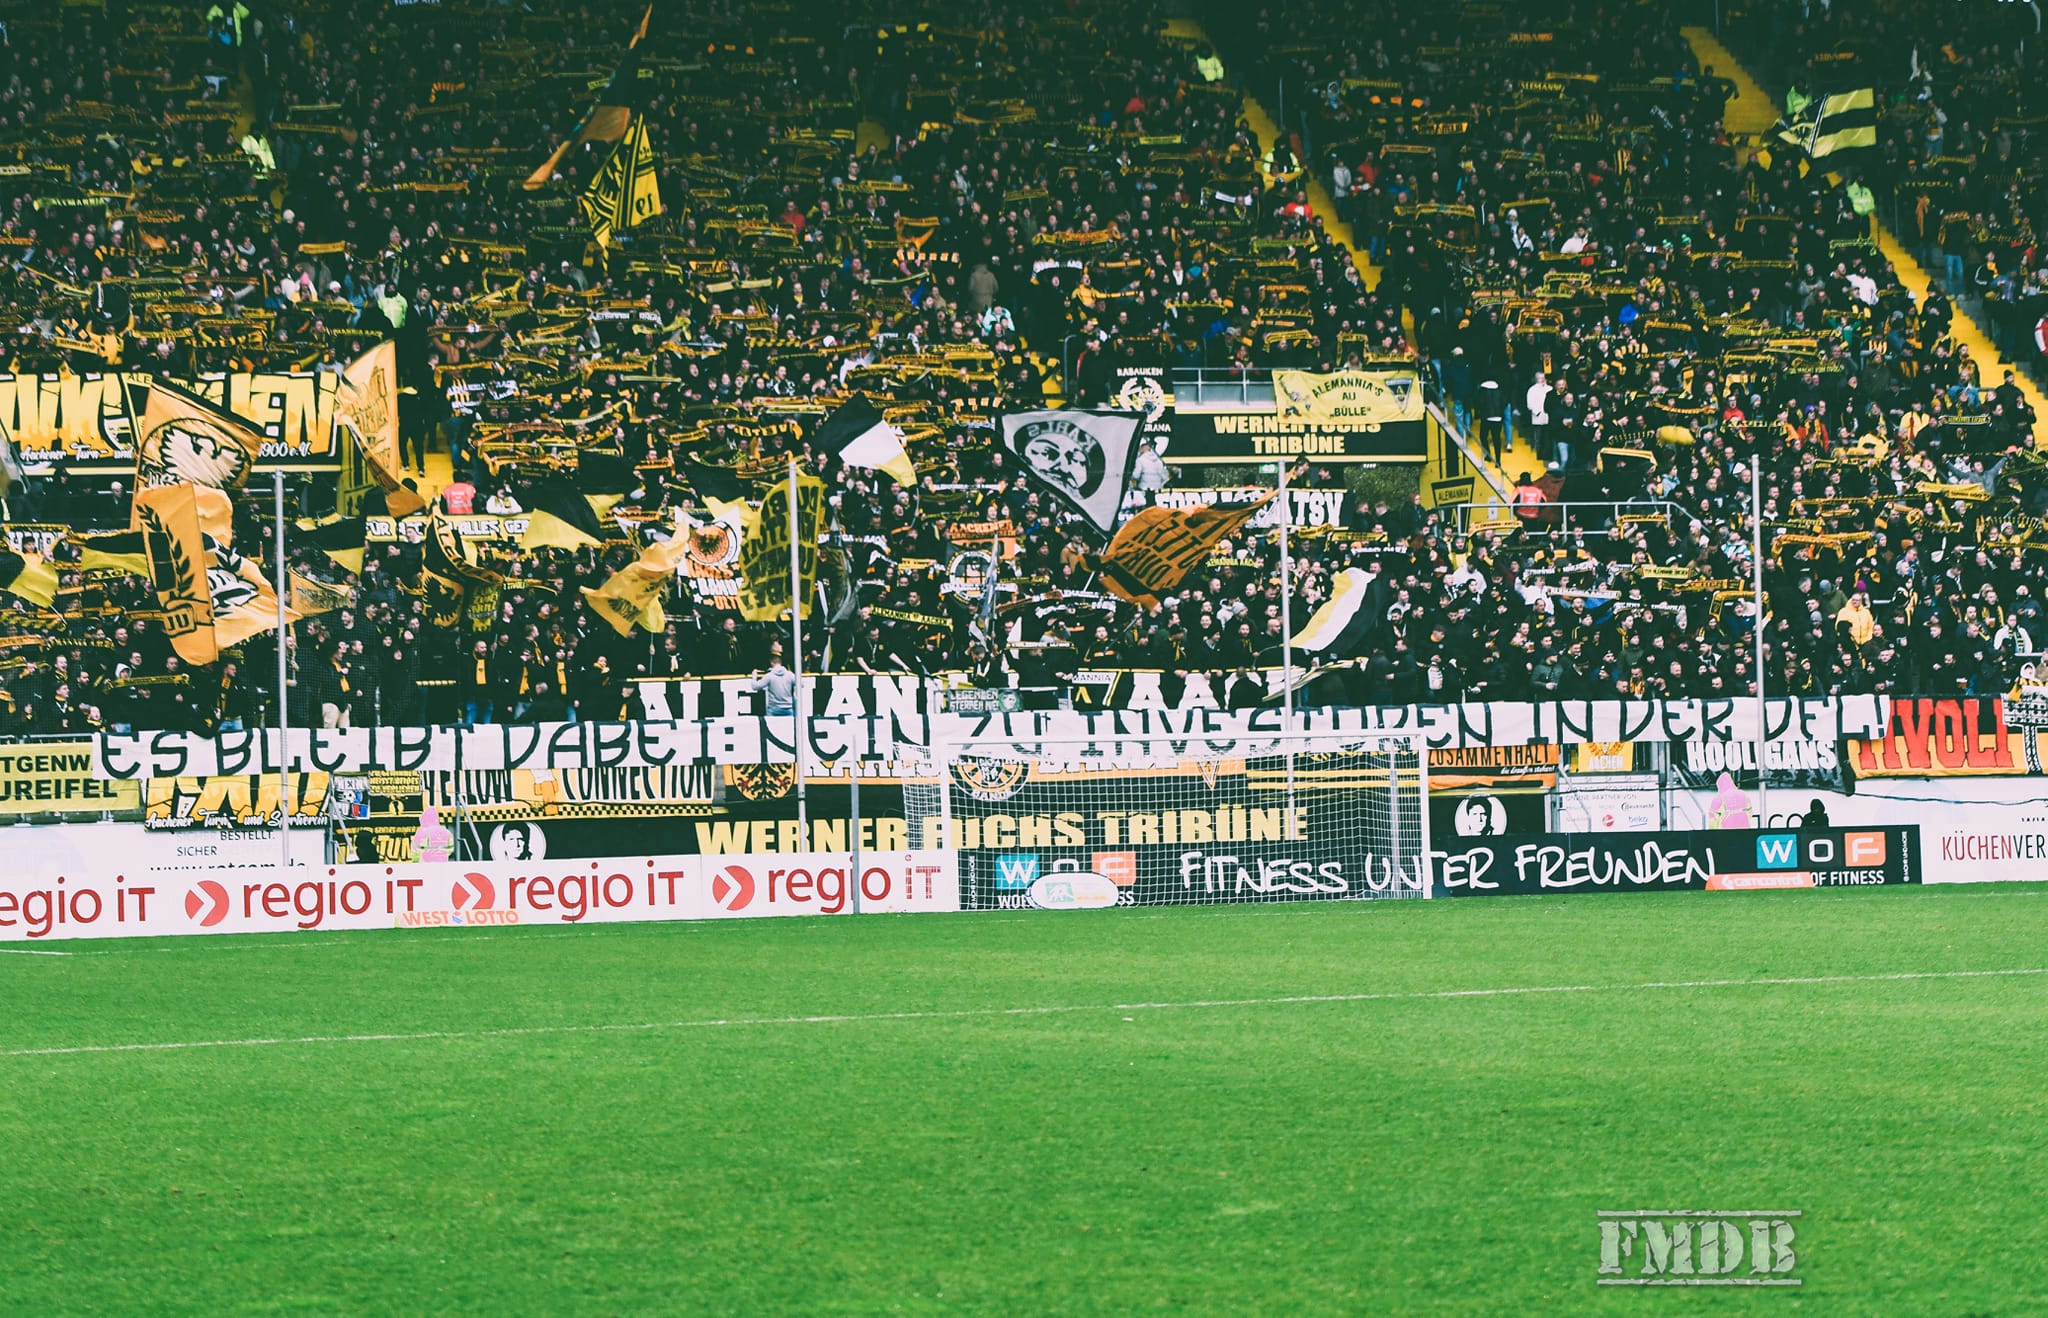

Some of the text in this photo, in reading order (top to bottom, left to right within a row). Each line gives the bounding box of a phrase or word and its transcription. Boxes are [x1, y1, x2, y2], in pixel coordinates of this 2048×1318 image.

[1312, 376, 1384, 398] ALEMANNIA'S
[1251, 434, 1345, 454] TRIBÜNE
[1438, 488, 1469, 501] ALEMANNIA
[99, 729, 189, 779] ES
[214, 724, 476, 777] BLEIBT
[499, 718, 735, 769] DABEI:
[759, 711, 930, 763] NEIN
[1526, 699, 1593, 746] IN
[1619, 697, 1735, 743] DER
[0, 754, 93, 774] TGENW
[1427, 743, 1551, 767] ZUSAMMENHALT
[561, 765, 713, 800] CONNECTION
[145, 812, 195, 830] Aachener
[243, 812, 265, 827] und
[694, 803, 1309, 855] WERNER FUCHS TRIBÜNE
[176, 845, 218, 857] SICHER
[1942, 830, 2047, 861] KÜCHENVER
[1179, 841, 1716, 894] FITNESS UNTER FREUNDEN
[1830, 869, 1885, 885] FITNESS
[242, 868, 373, 930] regio
[508, 861, 634, 922] regio
[402, 910, 519, 926] WEST LOTTO
